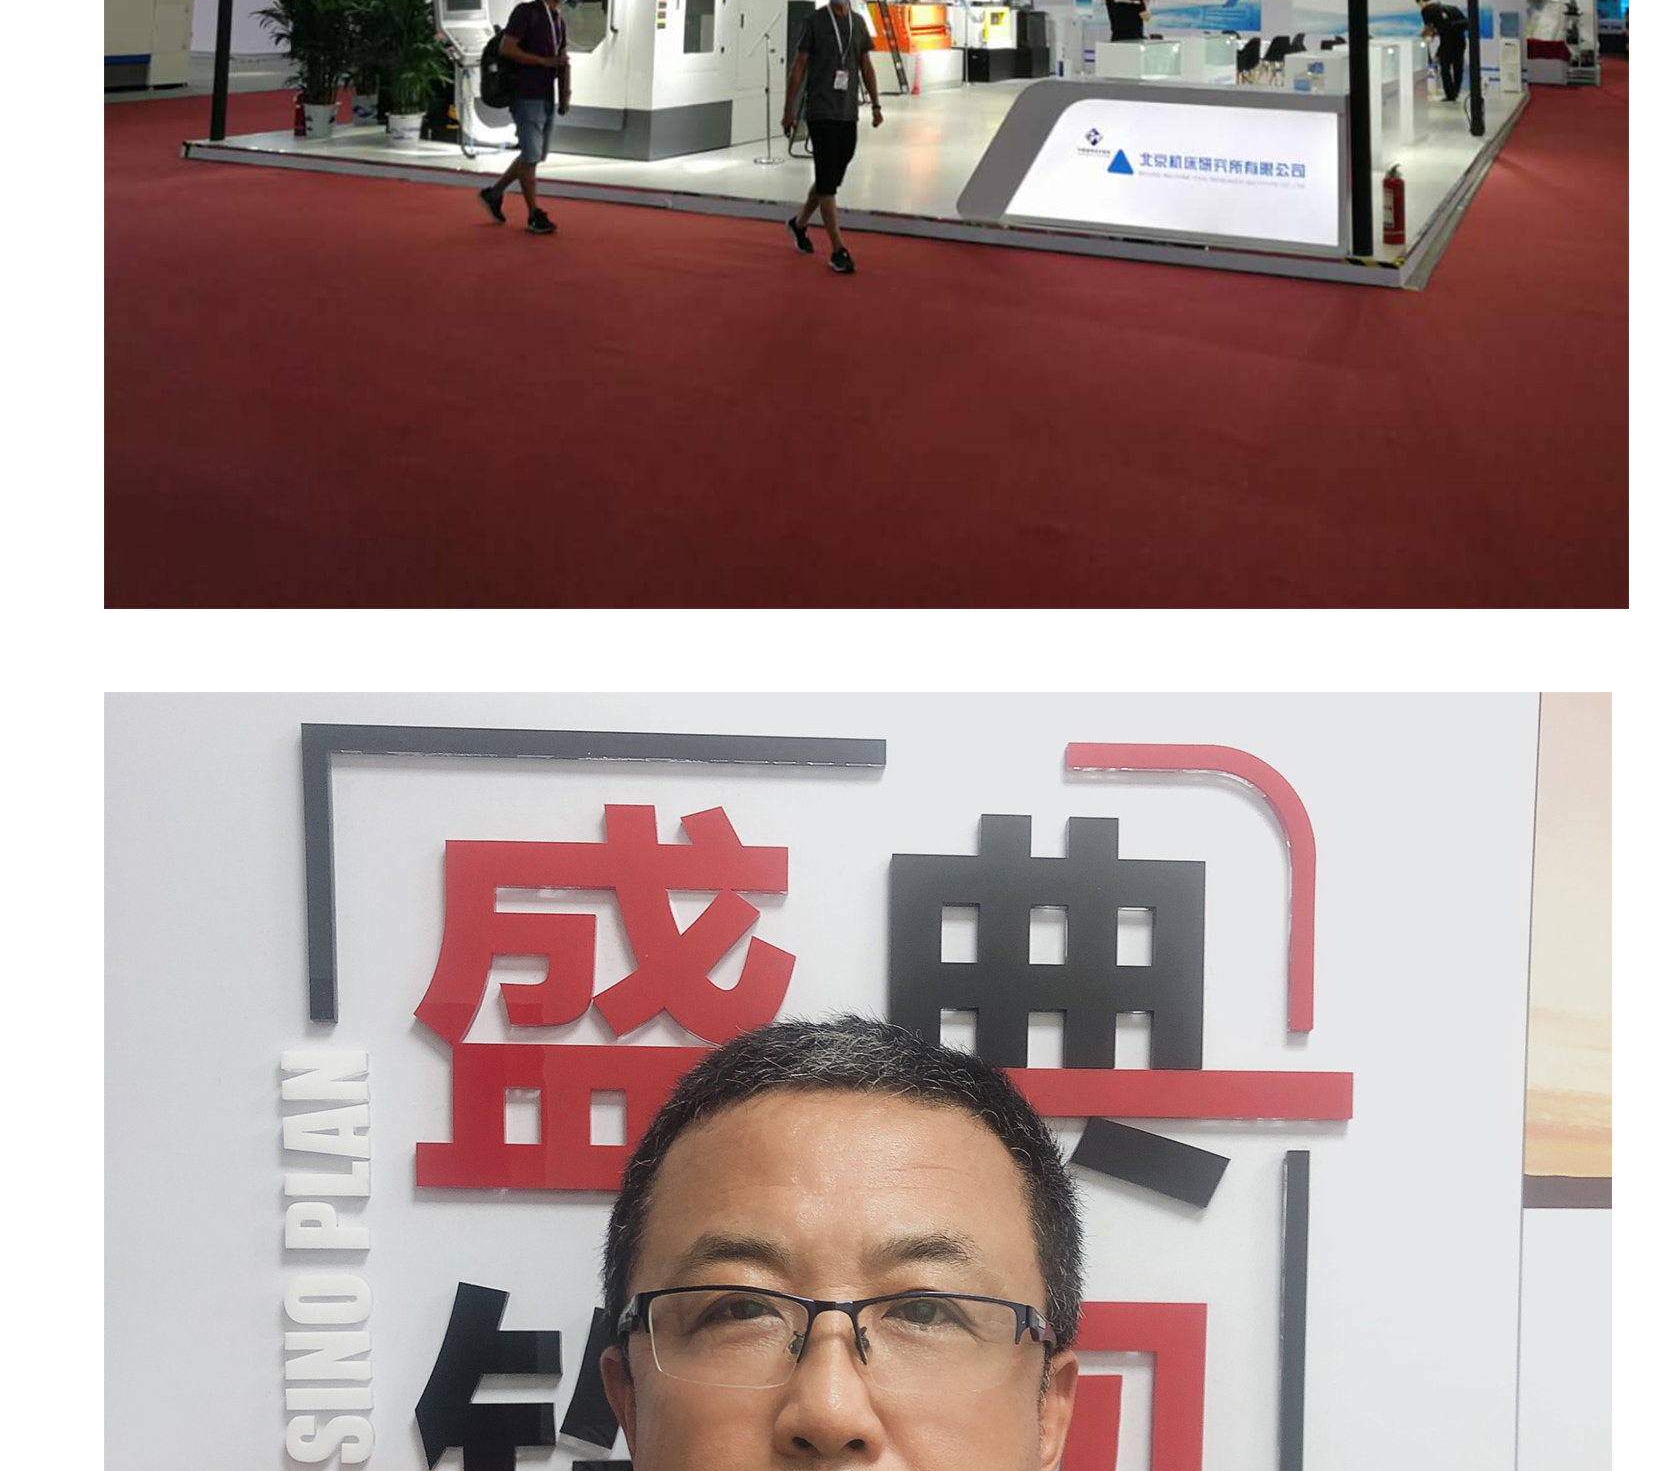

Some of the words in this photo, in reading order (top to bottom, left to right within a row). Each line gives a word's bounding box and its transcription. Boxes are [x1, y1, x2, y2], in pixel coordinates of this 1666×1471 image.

[1139, 152, 1306, 179] 北京机床研究所有限公司
[281, 1050, 372, 1251] PLAN
[285, 1273, 376, 1465] SINO
